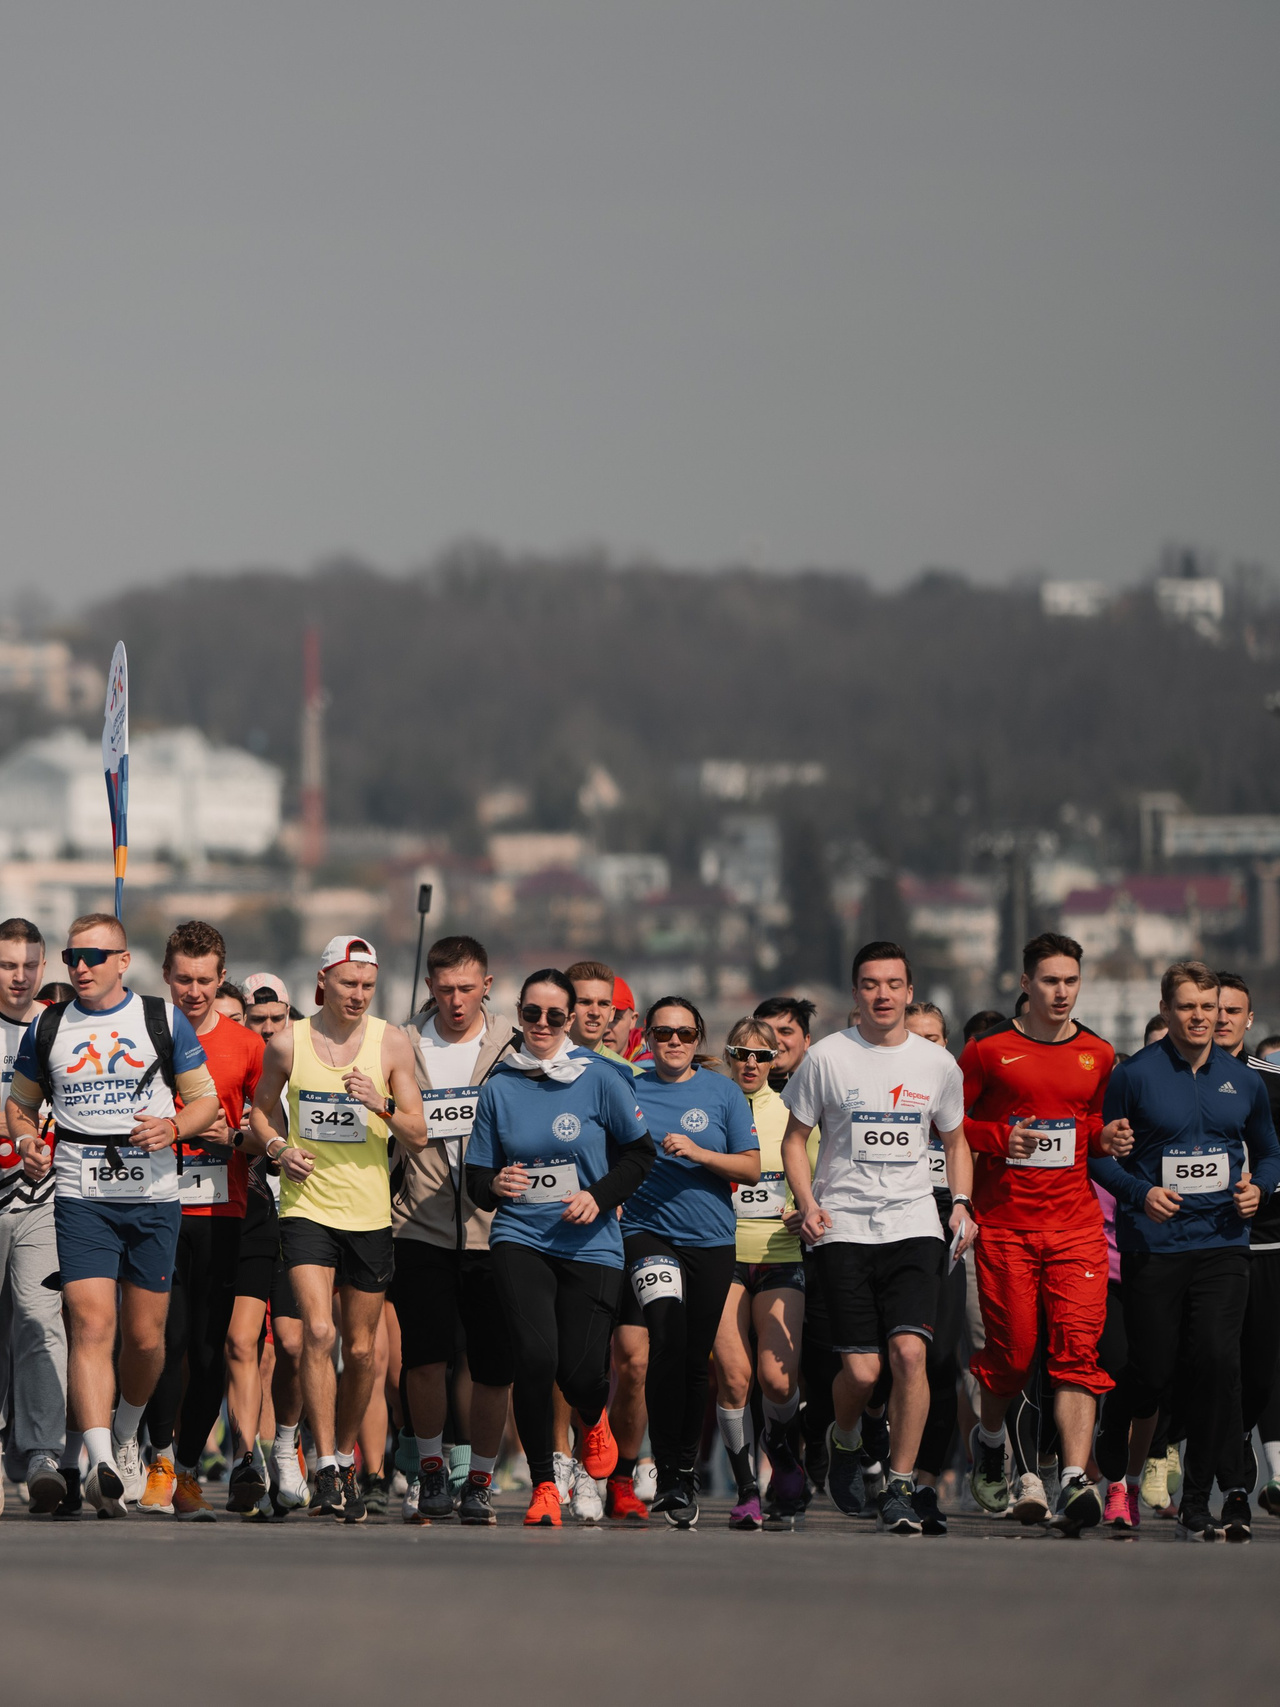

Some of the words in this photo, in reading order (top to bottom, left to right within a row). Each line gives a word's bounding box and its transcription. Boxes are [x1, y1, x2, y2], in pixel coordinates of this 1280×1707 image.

[64, 1095, 101, 1106] ДРУГ
[902, 1089, 931, 1102] Первые
[77, 1108, 136, 1117] АЭРОФЛОТ
[310, 1109, 355, 1127] 342
[429, 1104, 474, 1122] 468
[863, 1130, 910, 1146] 606
[88, 1165, 145, 1182] 1866
[1175, 1162, 1218, 1179] 582
[192, 1173, 201, 1189] 1
[527, 1174, 557, 1189] 70
[740, 1189, 769, 1203] 83
[635, 1270, 673, 1293] 296
